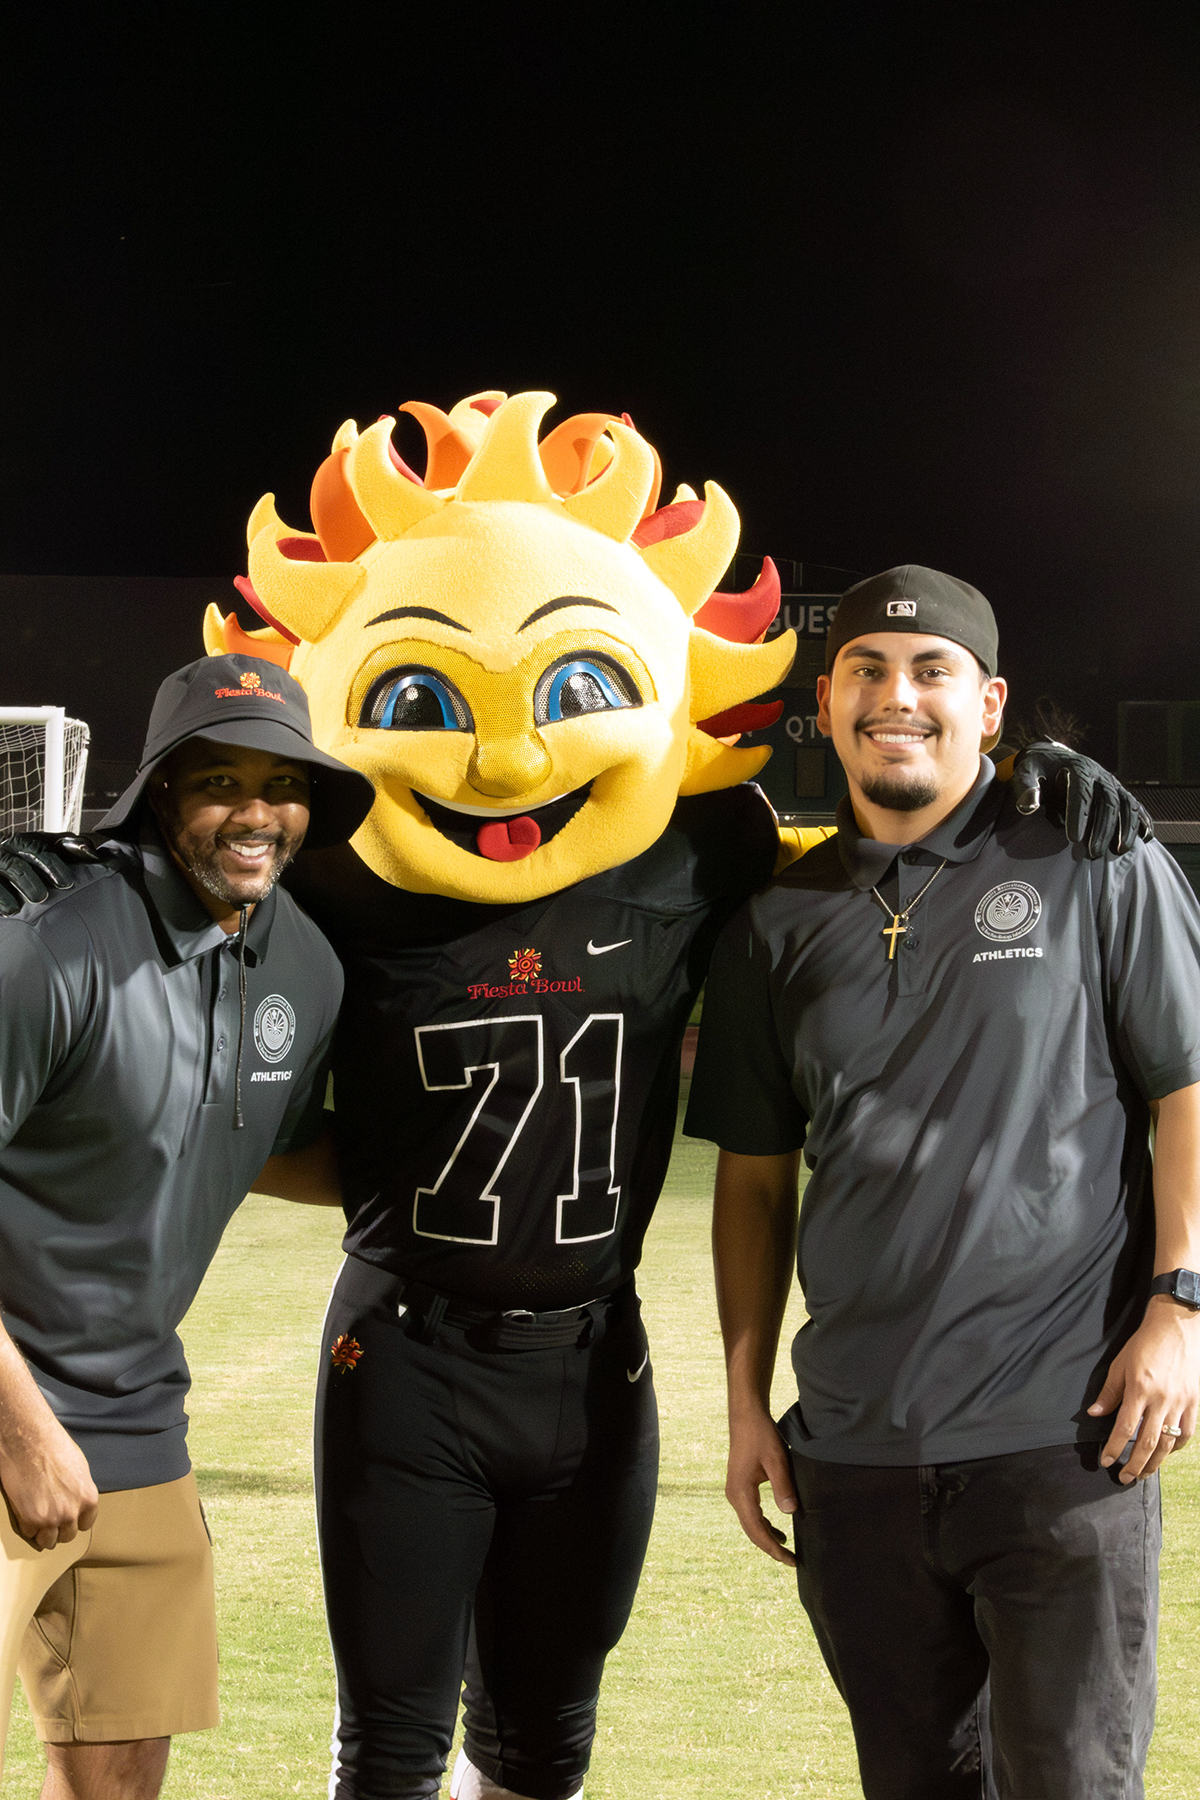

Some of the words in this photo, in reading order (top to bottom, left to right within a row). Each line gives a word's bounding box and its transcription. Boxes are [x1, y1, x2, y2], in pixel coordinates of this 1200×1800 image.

[214, 687, 253, 699] Fiesta
[785, 715, 832, 743] QT
[972, 948, 1043, 963] ATHLETICS
[467, 982, 528, 1000] Fiesta
[530, 976, 583, 994] Bowl
[412, 1013, 624, 1246] 71
